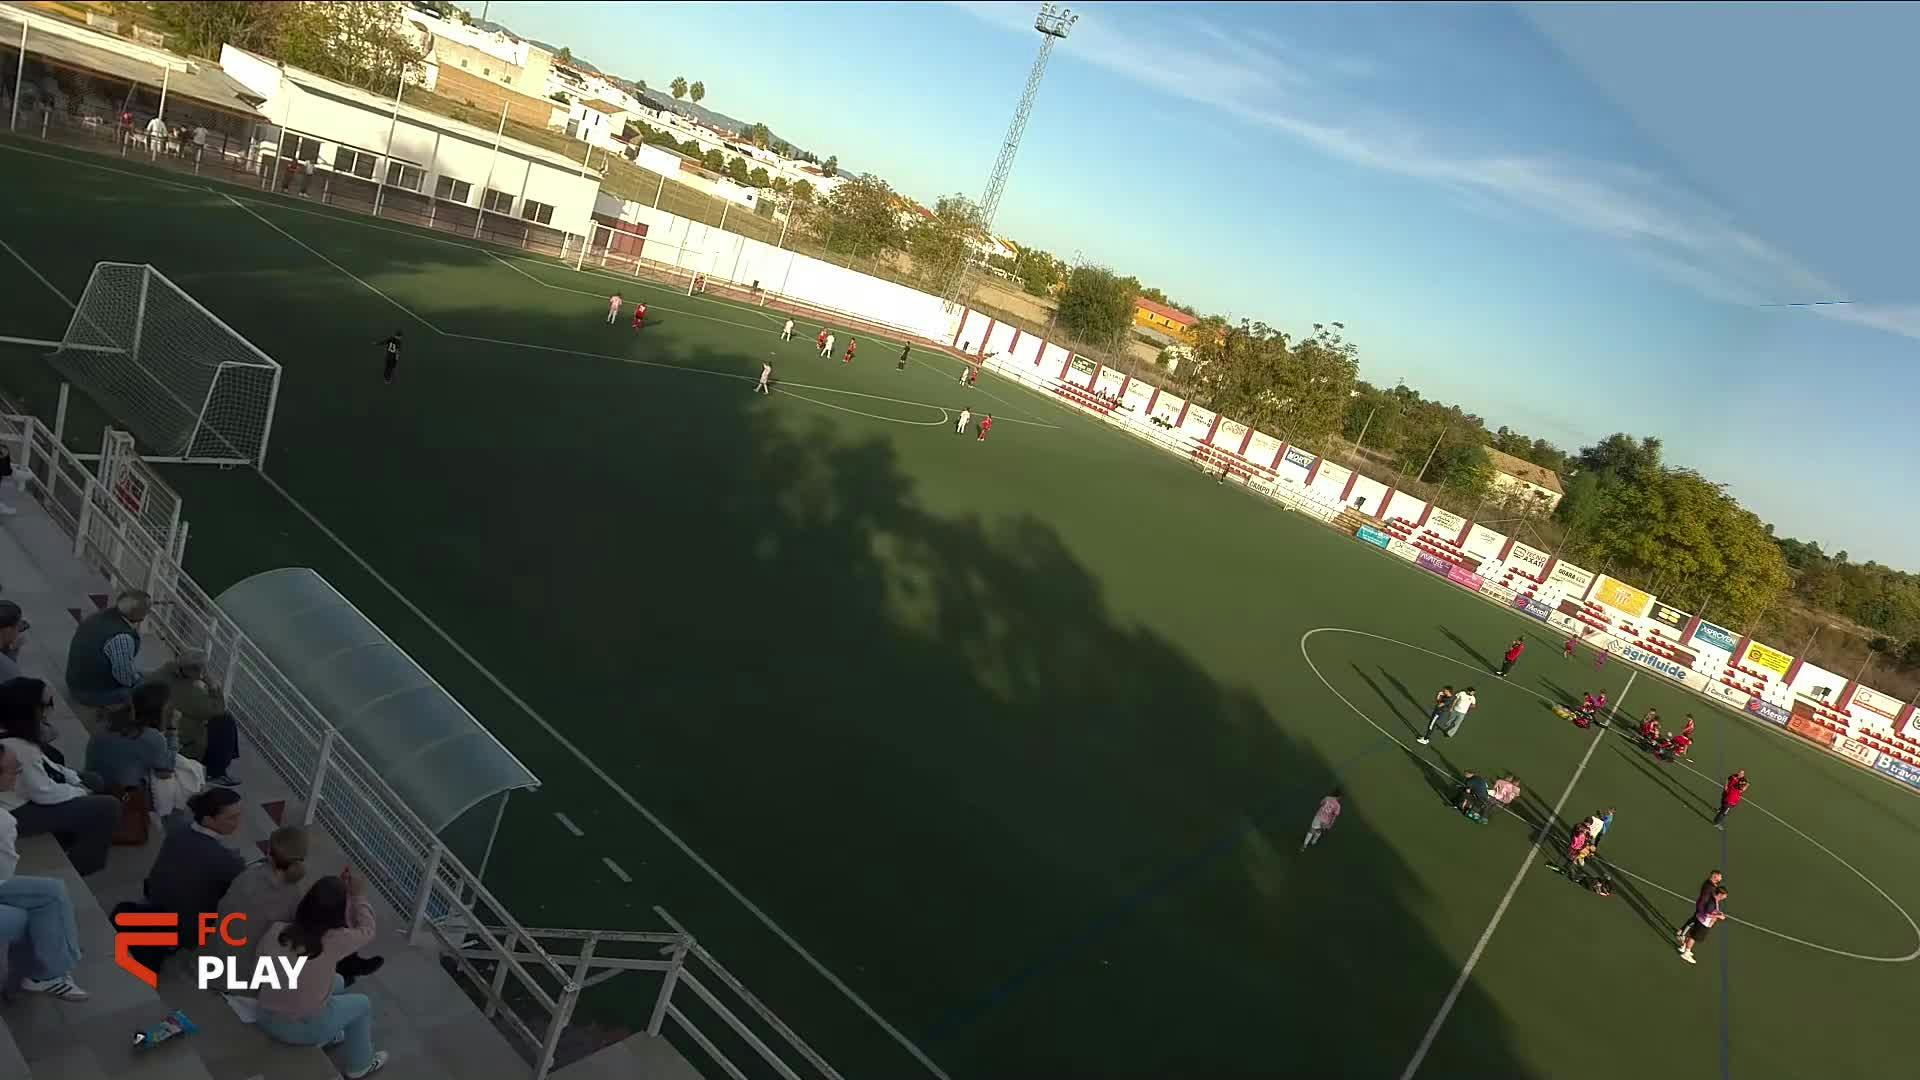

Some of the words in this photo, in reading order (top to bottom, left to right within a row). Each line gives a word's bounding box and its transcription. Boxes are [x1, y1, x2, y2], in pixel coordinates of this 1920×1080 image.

[1526, 550, 1547, 563] TECNO
[1622, 645, 1687, 680] agrifluide
[1761, 706, 1788, 724] Meroil
